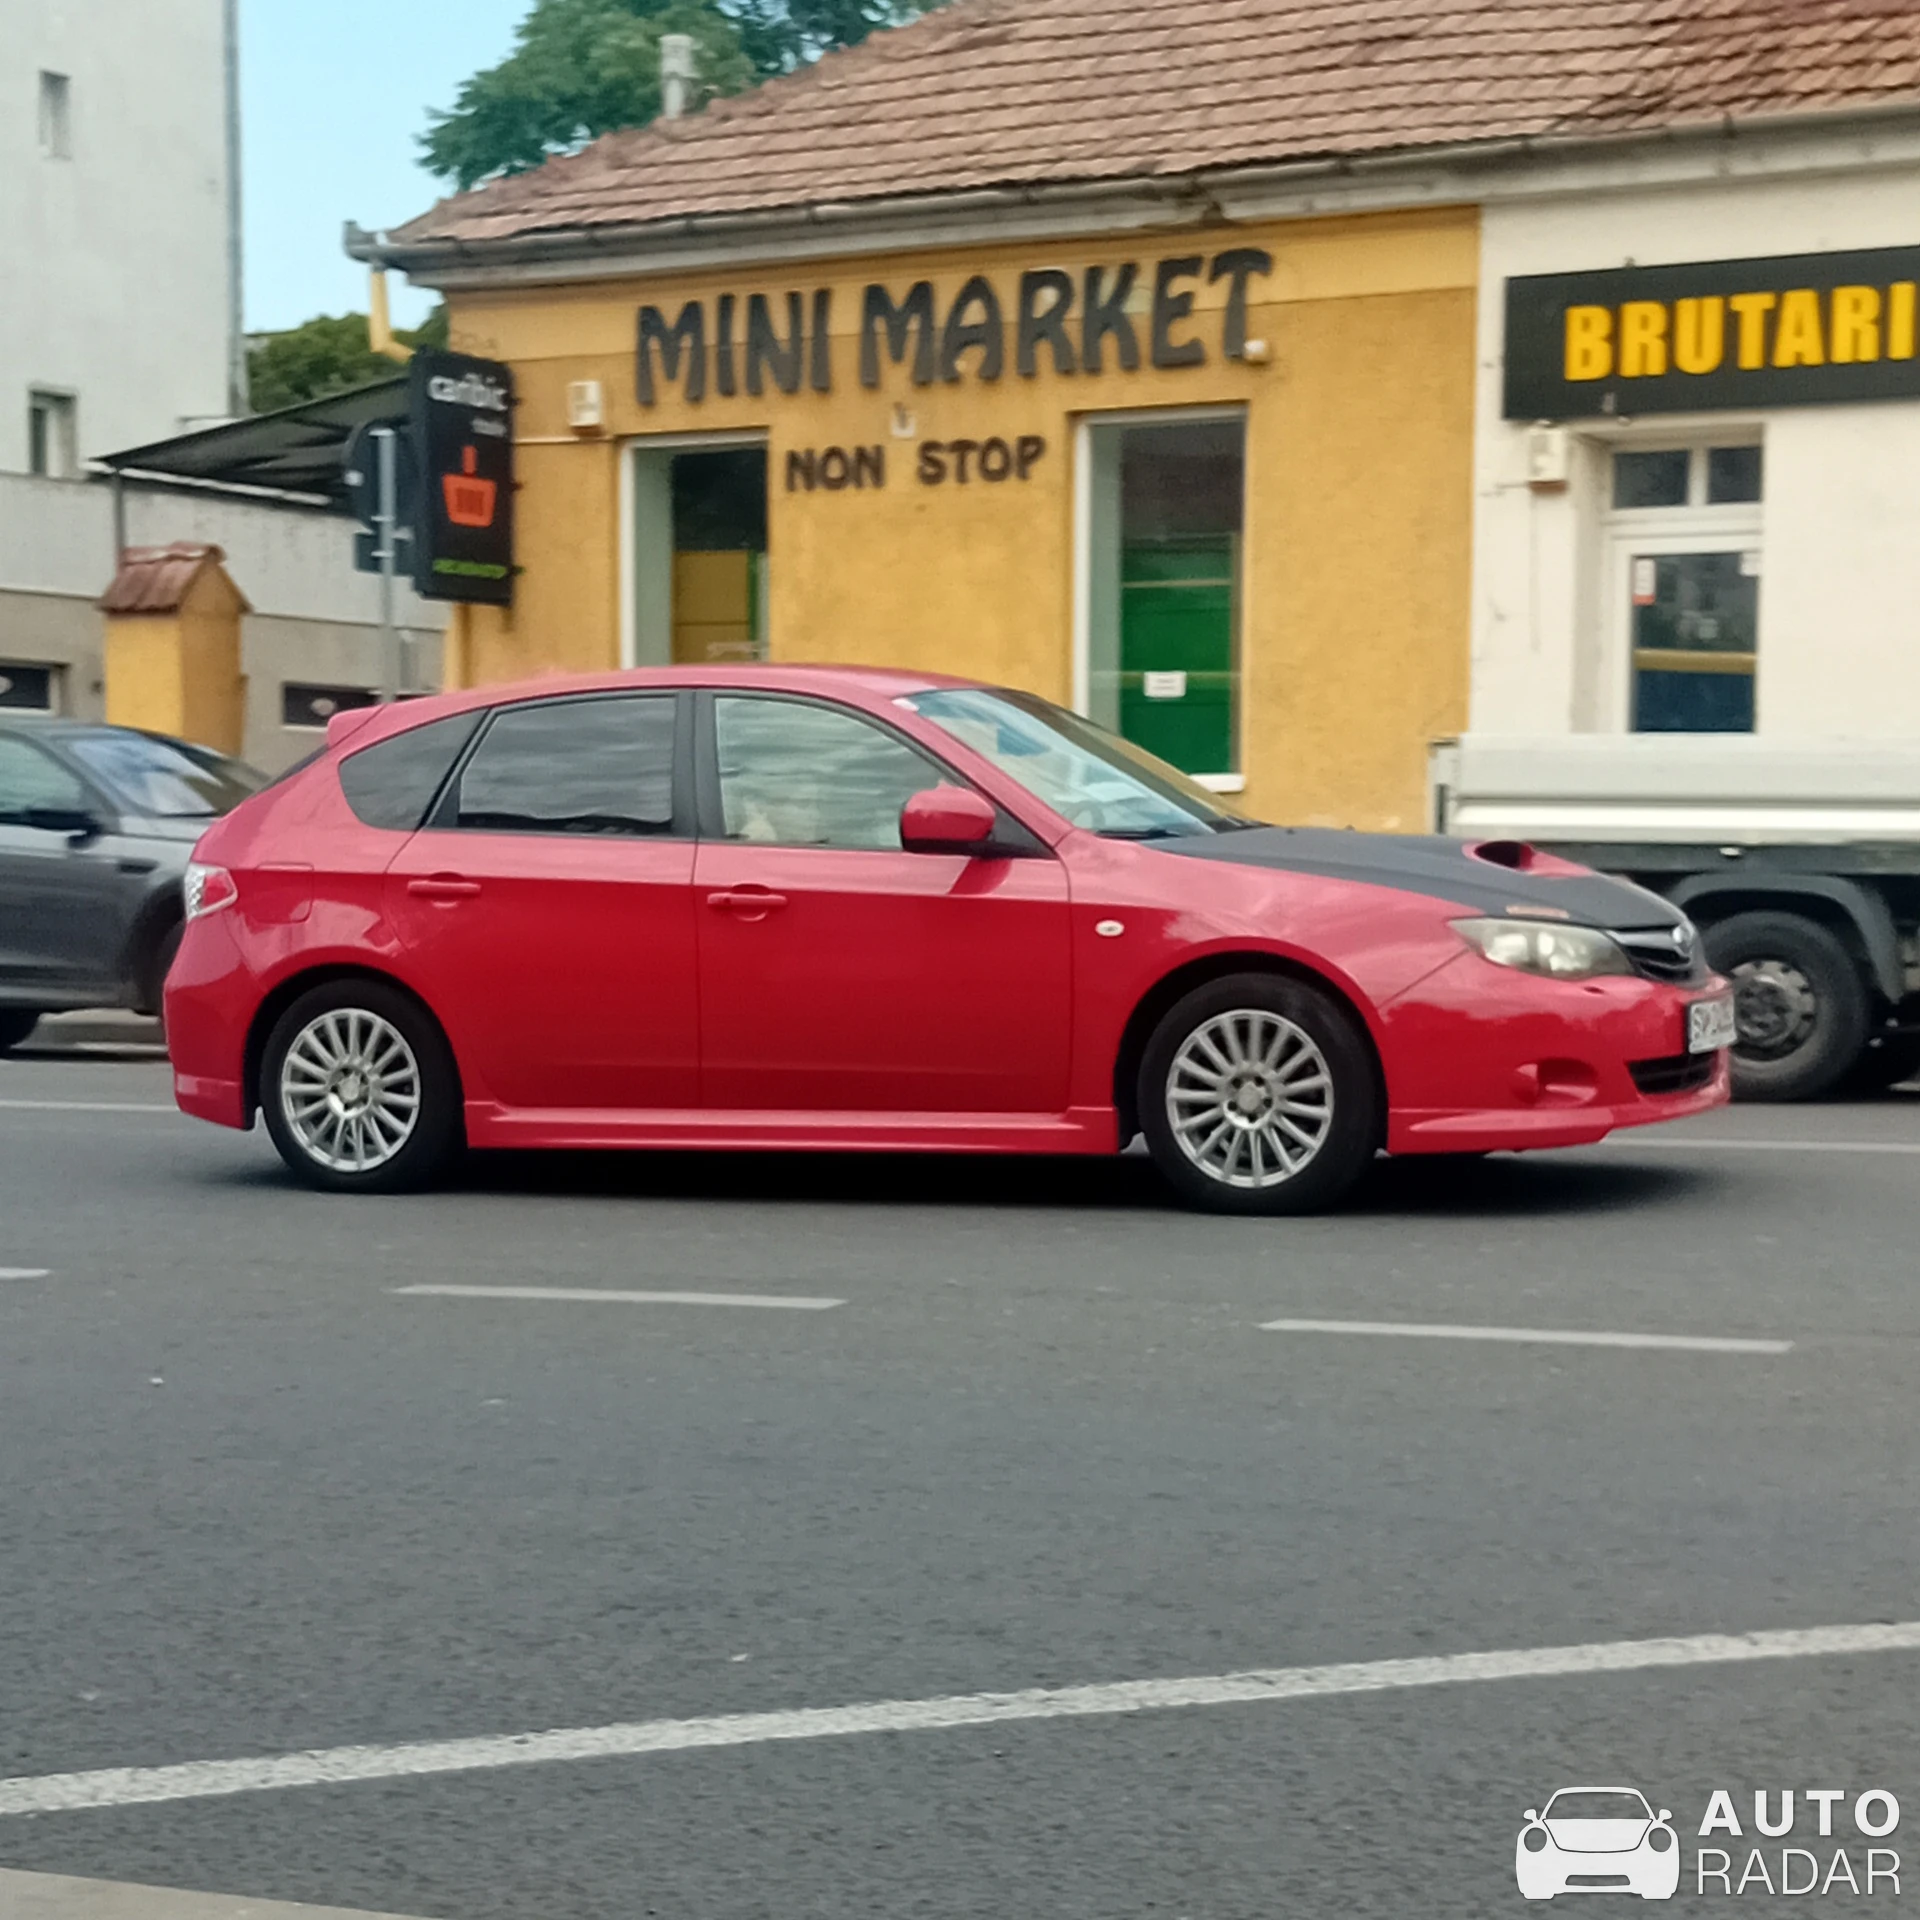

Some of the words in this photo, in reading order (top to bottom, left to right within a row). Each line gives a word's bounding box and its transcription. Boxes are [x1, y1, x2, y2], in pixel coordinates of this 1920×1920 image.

[635, 288, 831, 406] MINI
[860, 247, 1272, 386] MARKET
[1564, 281, 1916, 380] BRUTARI
[785, 444, 884, 491] NON
[916, 435, 1046, 484] STOP
